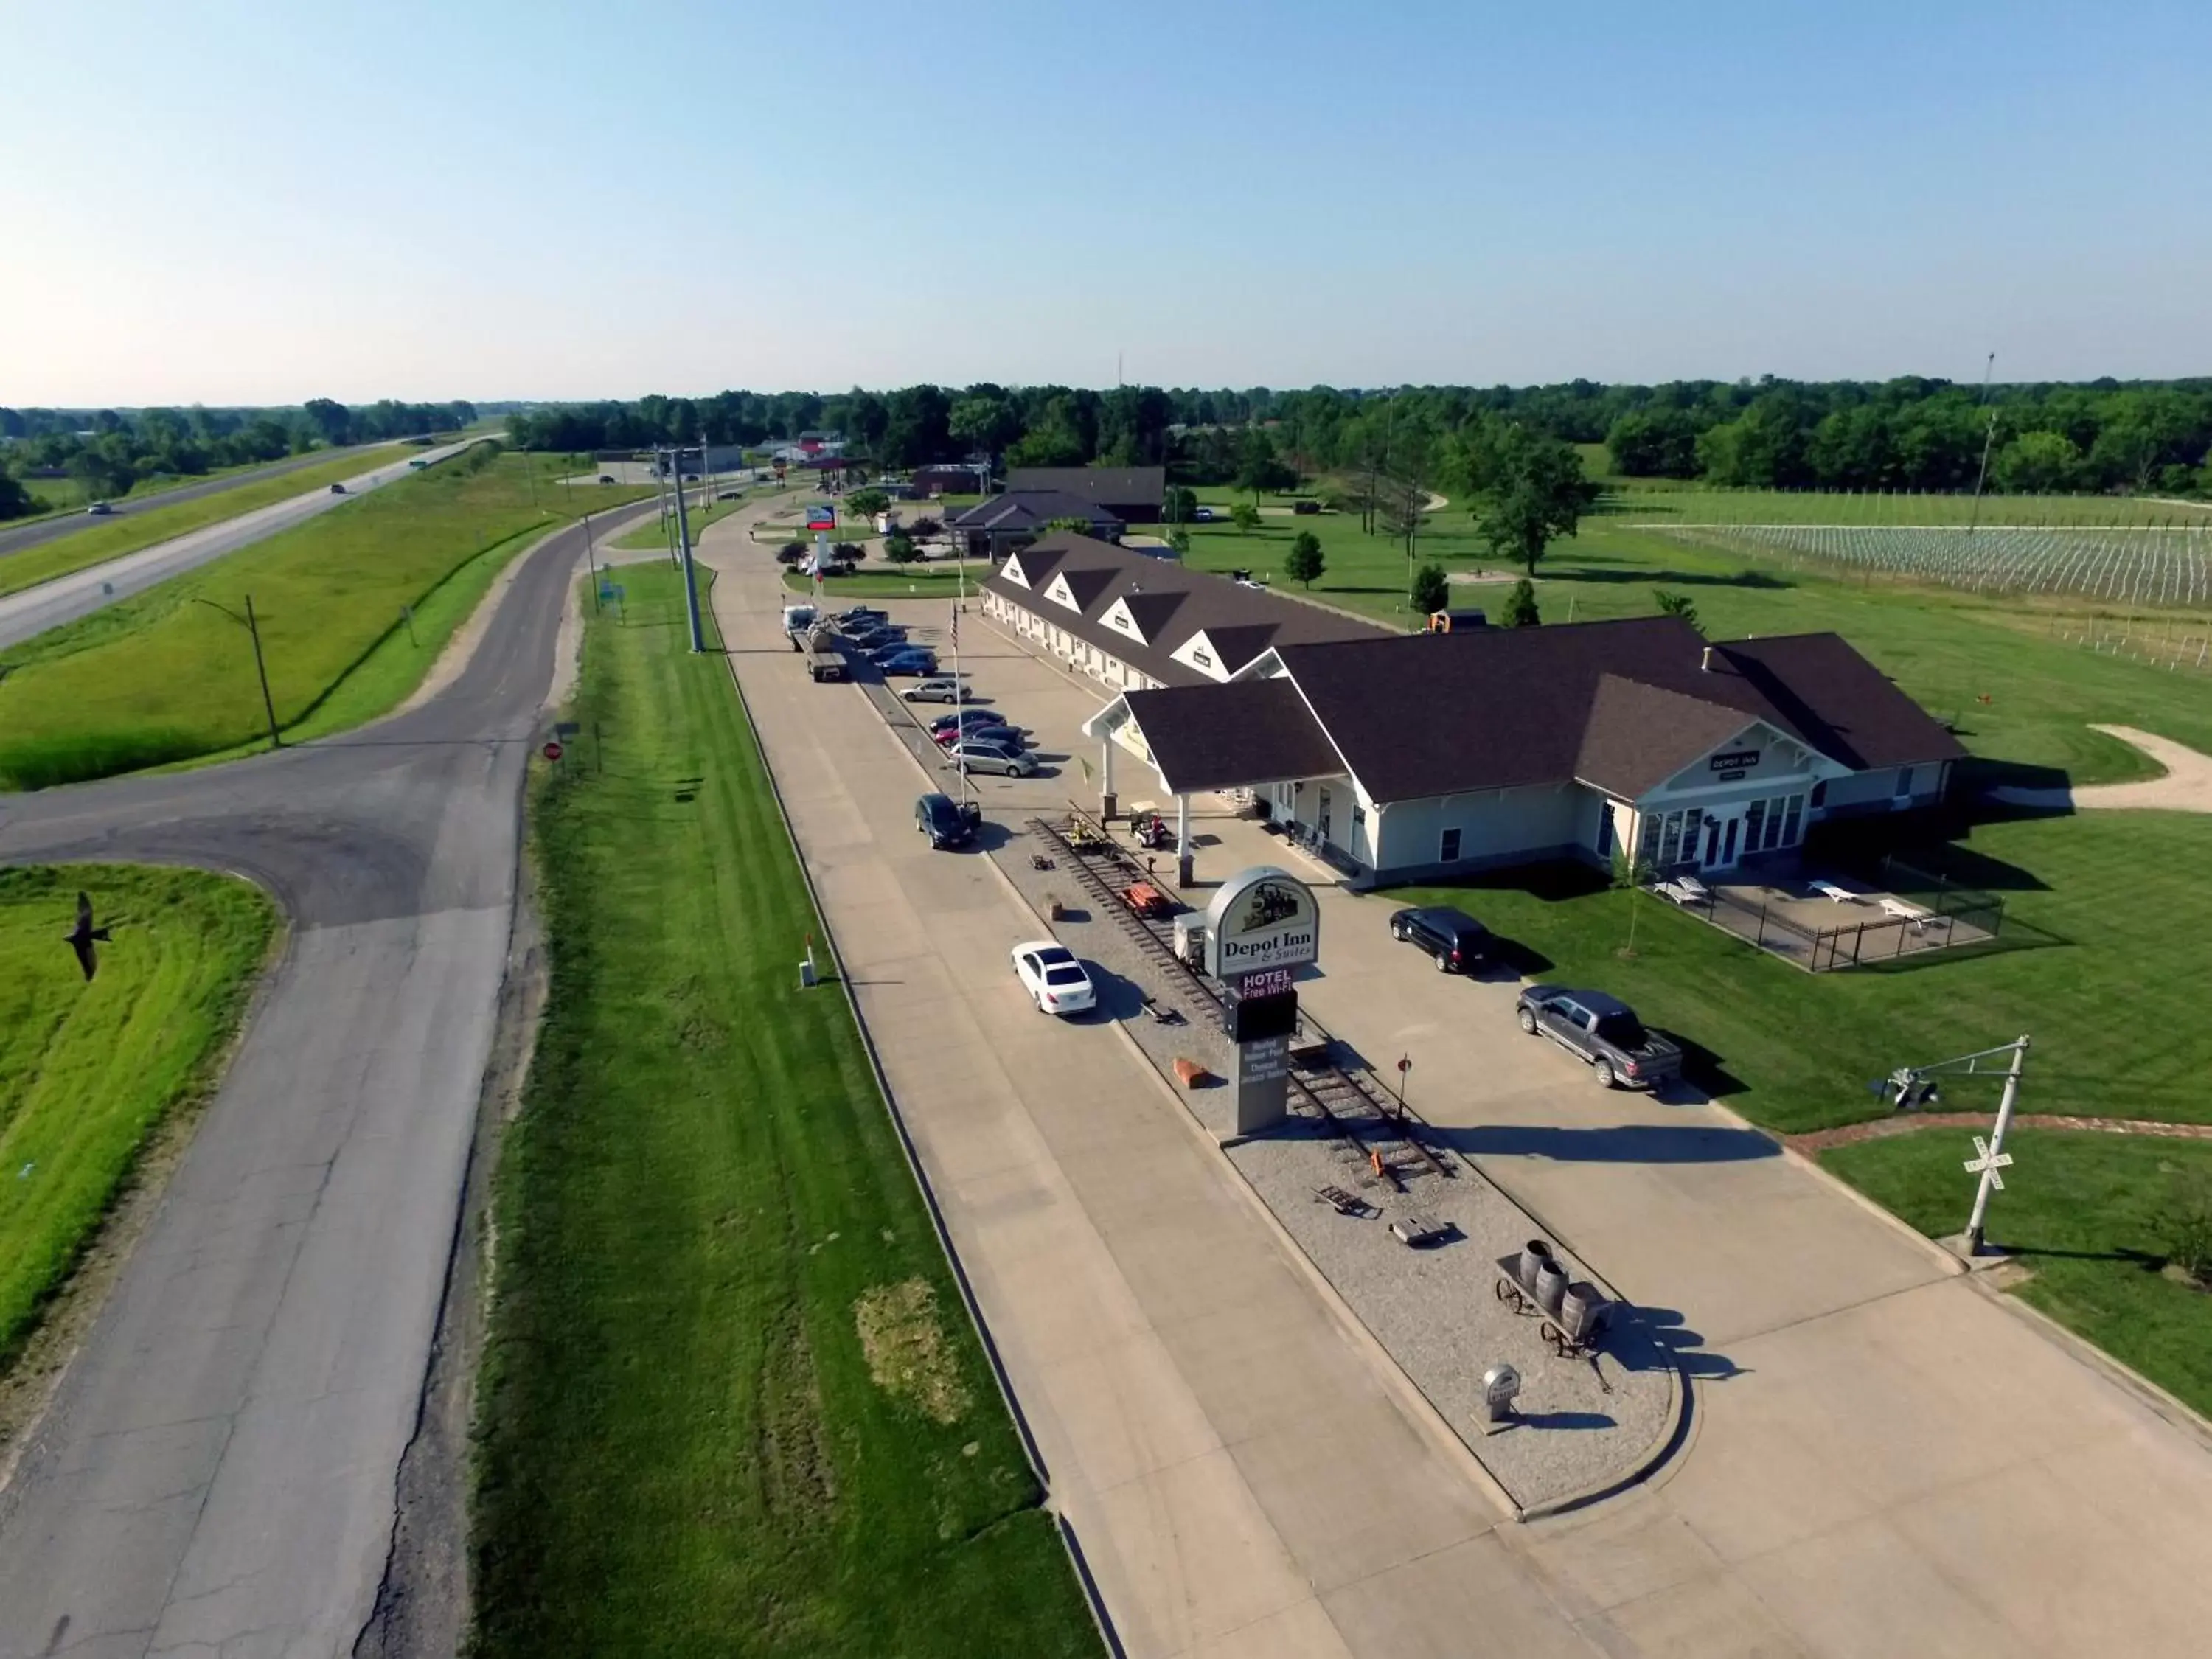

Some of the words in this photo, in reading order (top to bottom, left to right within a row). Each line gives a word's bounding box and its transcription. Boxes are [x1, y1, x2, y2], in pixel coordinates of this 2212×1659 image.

[1225, 936, 1279, 956] Depot
[1284, 932, 1311, 947] Inn
[1262, 953, 1272, 961] &
[1275, 947, 1311, 960] Suites
[1244, 970, 1292, 987] HOTEL
[1244, 987, 1265, 999] Free
